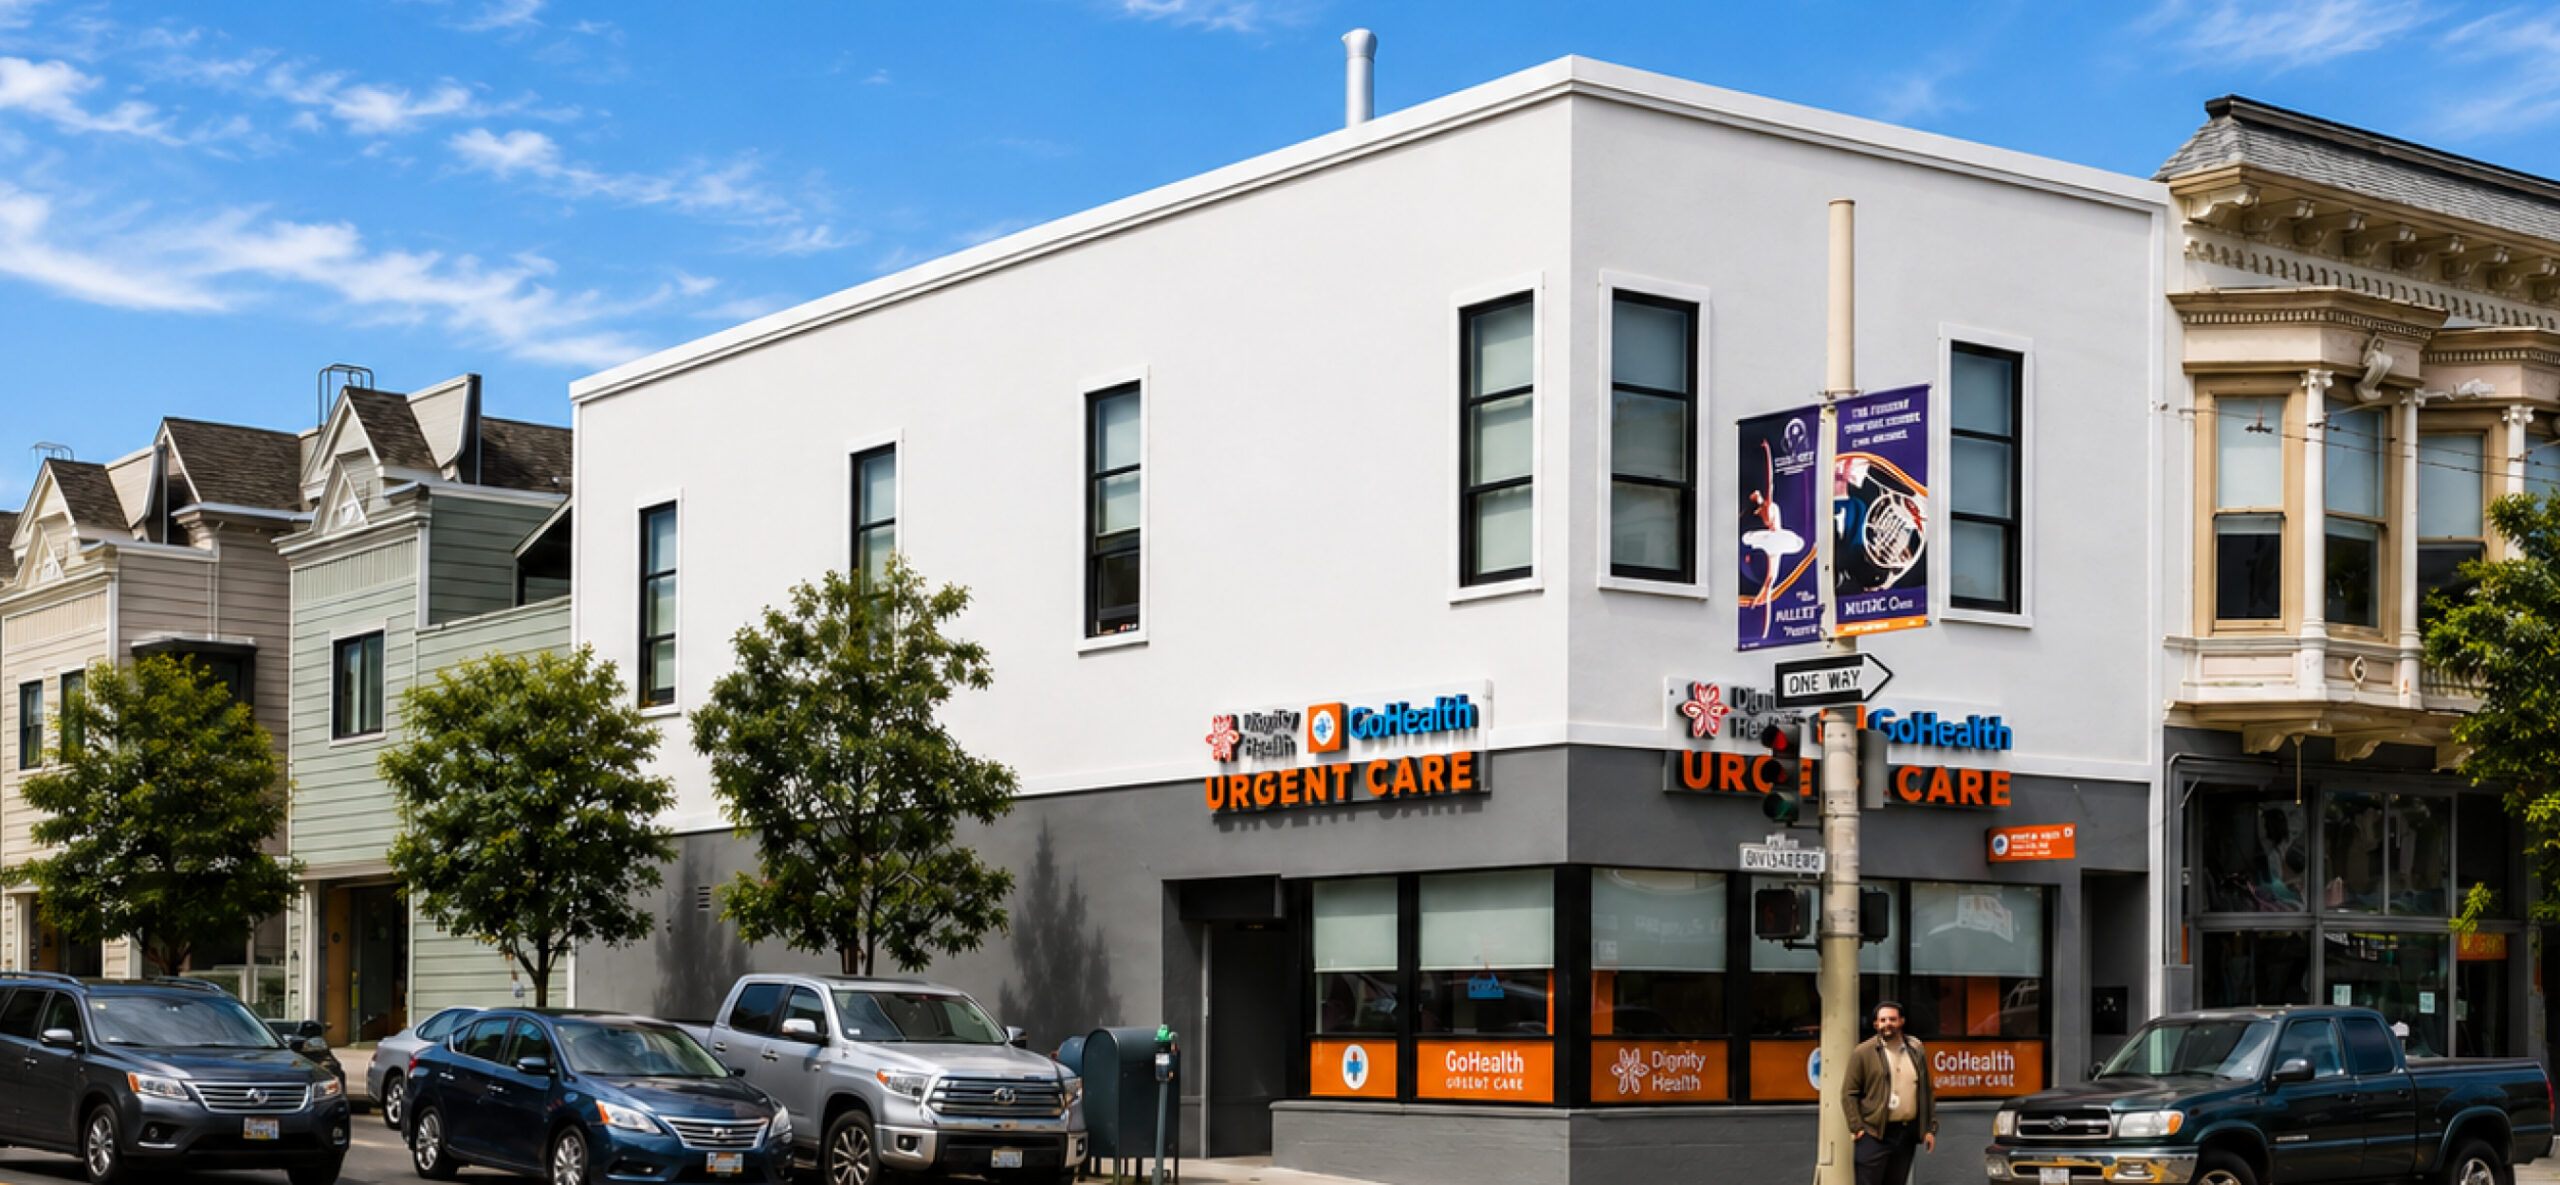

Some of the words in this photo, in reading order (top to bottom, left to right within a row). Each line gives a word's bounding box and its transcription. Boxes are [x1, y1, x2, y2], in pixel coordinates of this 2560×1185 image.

[1790, 674, 1819, 694] ONE
[1827, 665, 1860, 689] WAY
[1349, 694, 1472, 739] GoHealth
[1868, 708, 2011, 750] GoHealth
[1205, 763, 1351, 810] URGENT
[1366, 751, 1472, 796] CARE
[1896, 765, 2011, 807] CARE
[1446, 1049, 1524, 1073] GoHealth
[1652, 1050, 1706, 1073] Dignity
[1934, 1049, 2014, 1072] GoHealth
[1652, 1074, 1701, 1092] Health
